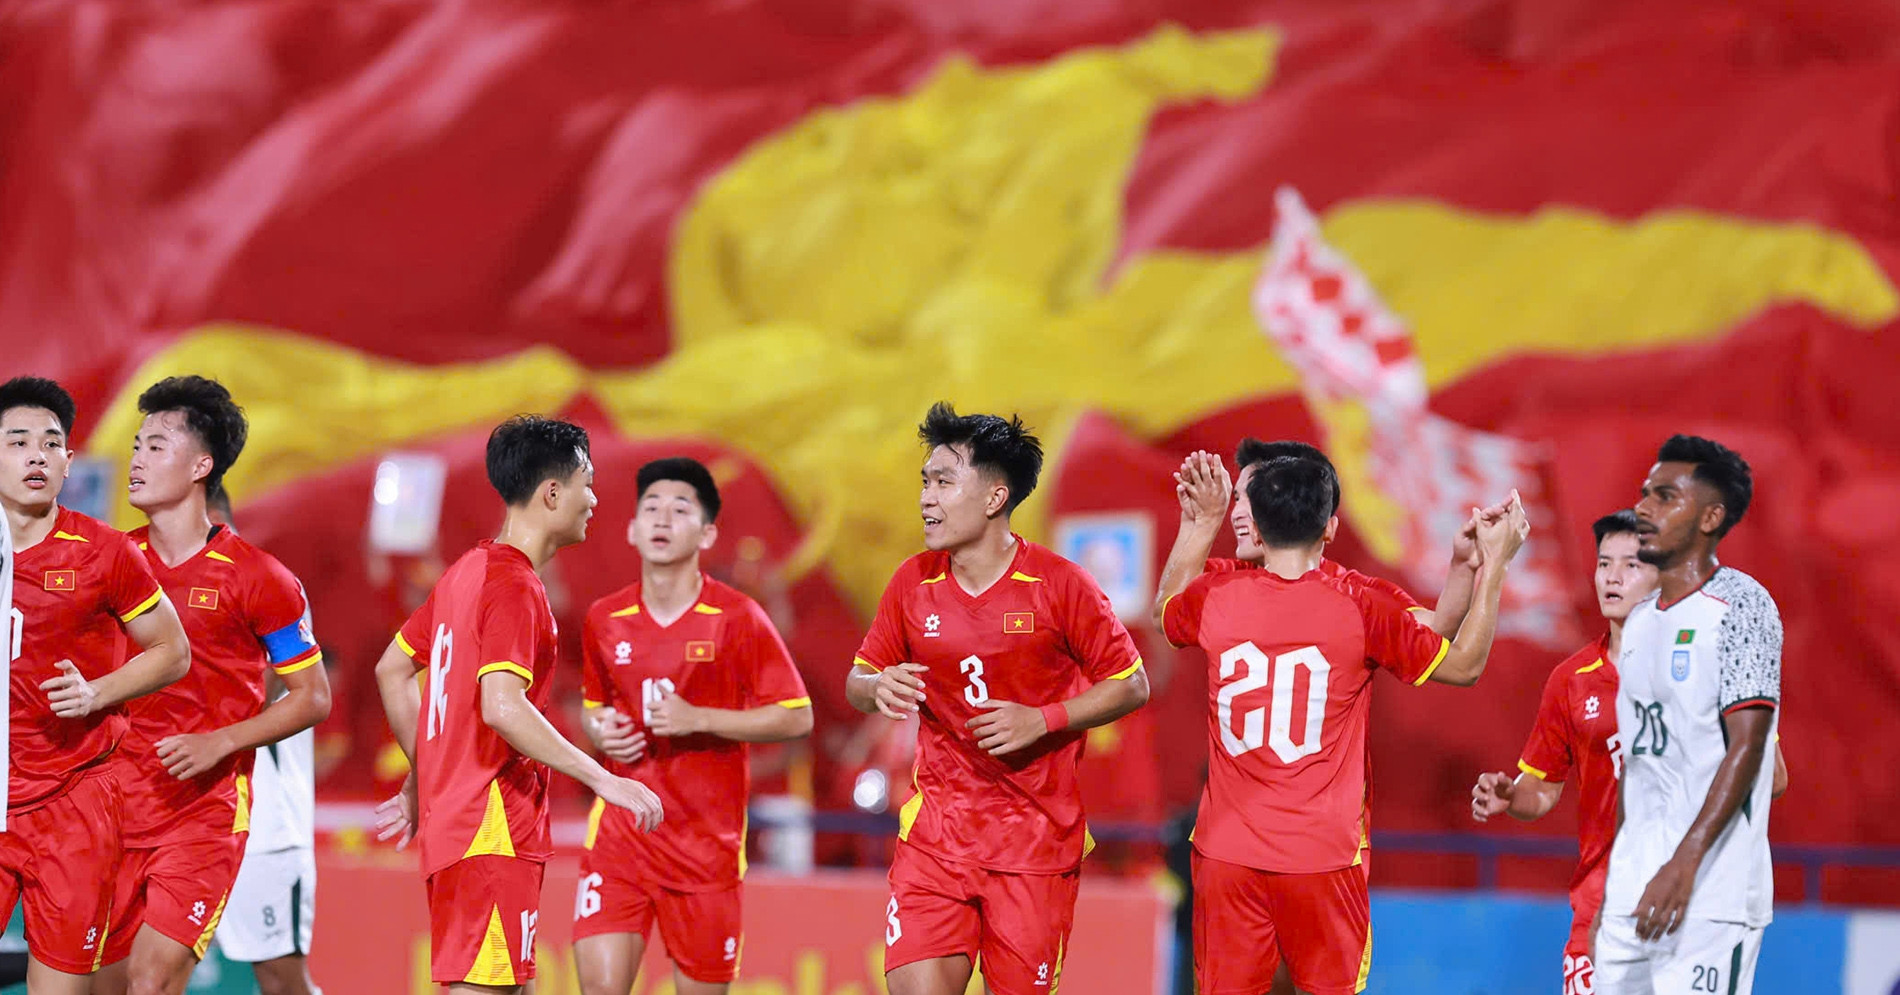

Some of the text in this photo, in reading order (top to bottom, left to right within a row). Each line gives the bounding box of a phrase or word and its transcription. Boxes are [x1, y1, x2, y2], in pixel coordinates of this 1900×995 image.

[960, 654, 988, 707] 3
[1217, 640, 1331, 765] 20
[1631, 700, 1669, 756] 20
[263, 905, 276, 927] 8
[574, 872, 603, 922] 16
[886, 895, 903, 947] 3
[1691, 965, 1719, 993] 20
